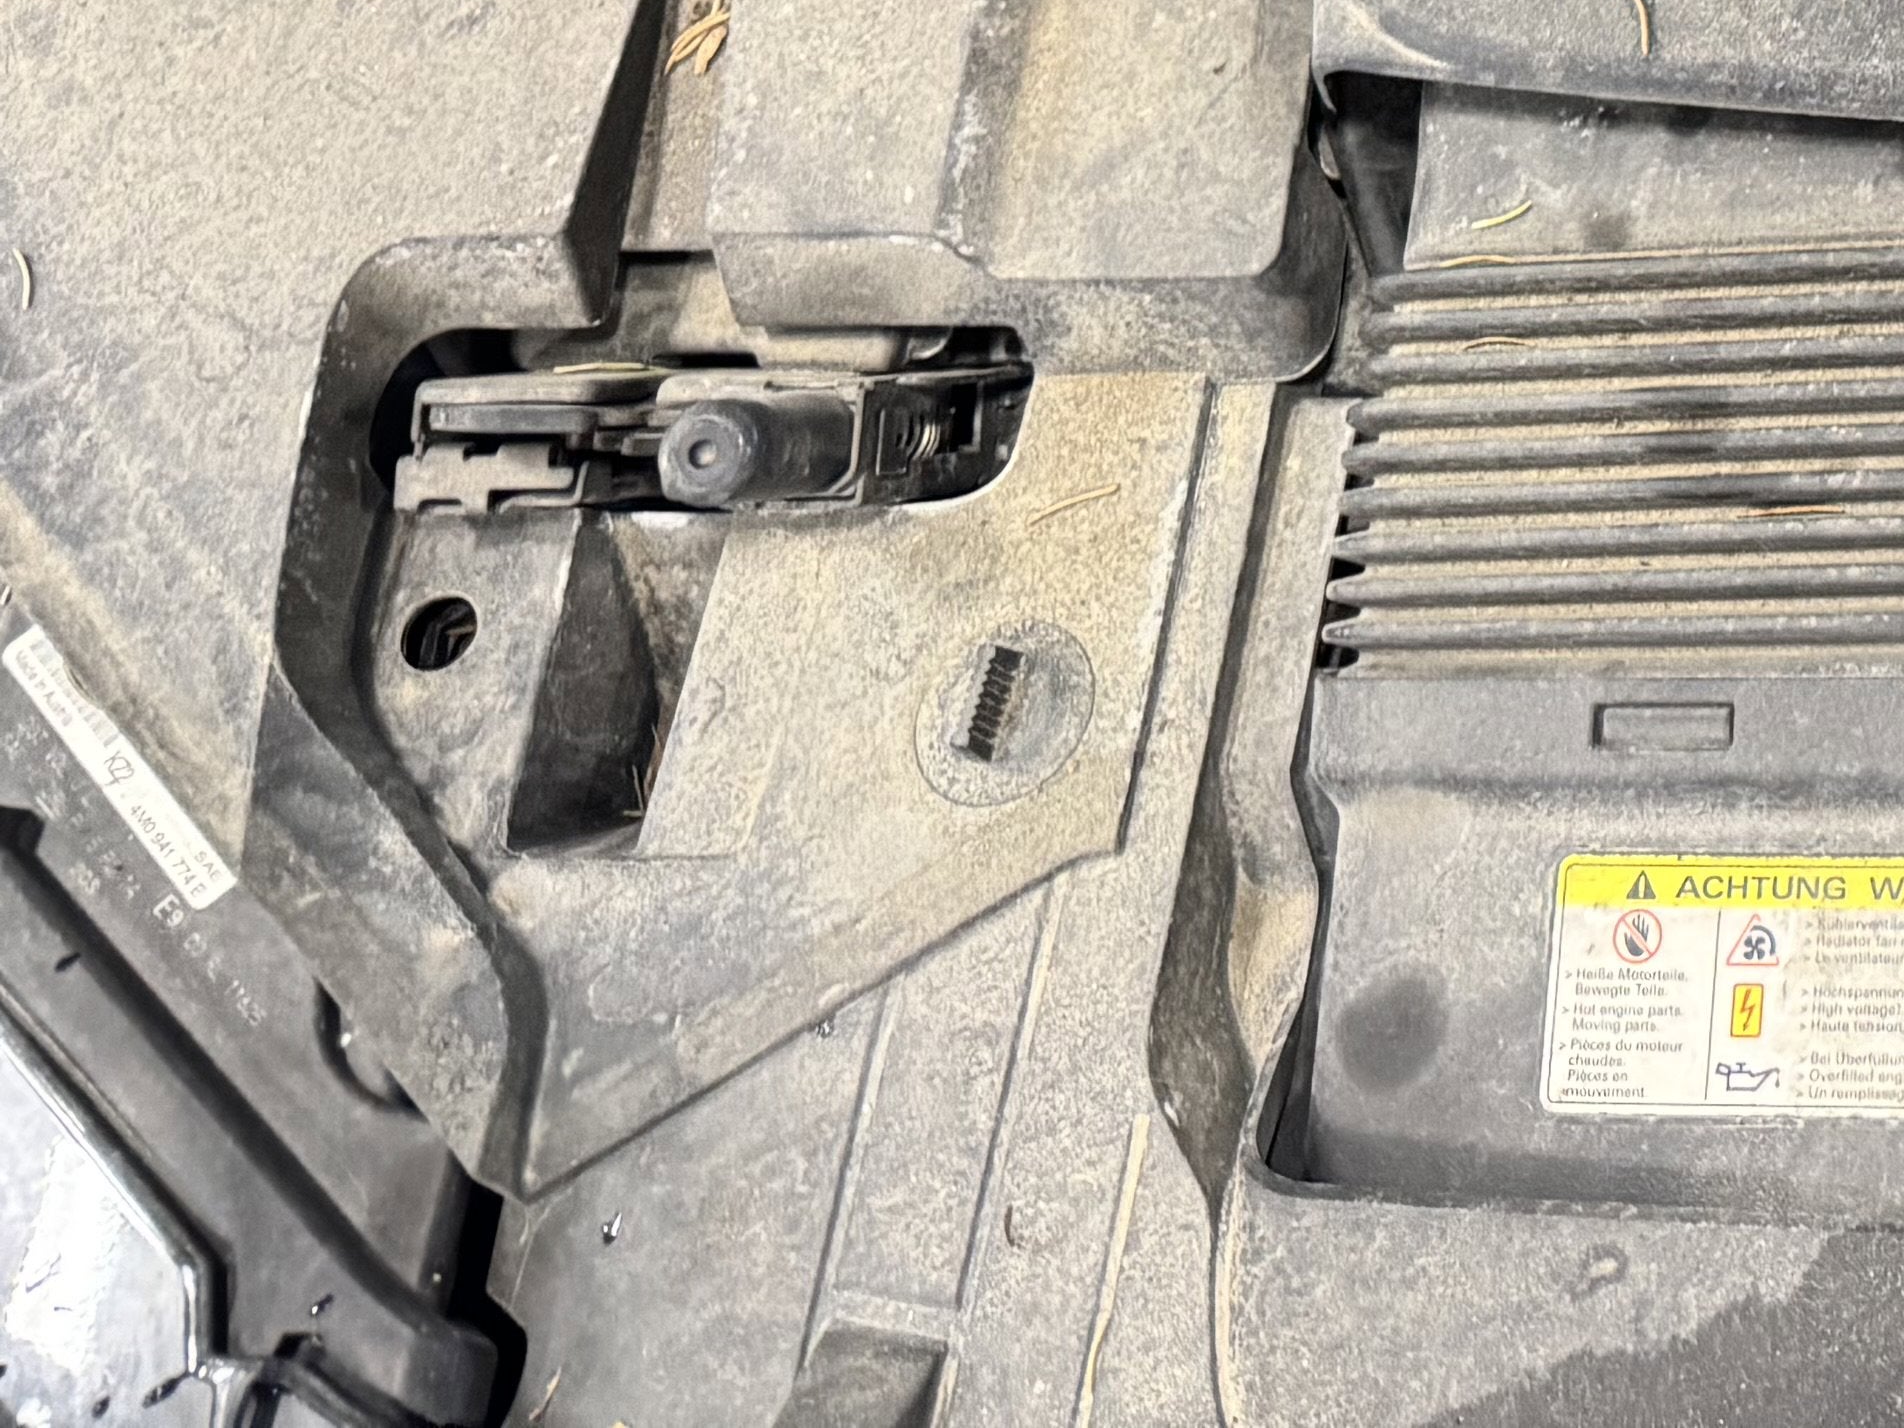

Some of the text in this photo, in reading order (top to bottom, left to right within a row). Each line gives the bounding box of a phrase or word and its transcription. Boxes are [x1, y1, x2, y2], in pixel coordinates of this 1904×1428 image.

[151, 832, 175, 859] 941
[172, 857, 197, 886] 774
[194, 850, 222, 882] SAE
[1676, 876, 1847, 901] ACHTUNG
[153, 894, 184, 927] E9
[1575, 982, 1630, 999] Bewegte
[1573, 1002, 1596, 1016] Hot
[1600, 1005, 1644, 1018] engine
[1812, 1002, 1842, 1017] High
[1572, 1017, 1621, 1034] Moving
[1615, 1039, 1632, 1051] du
[1636, 1040, 1683, 1052] moteur
[1810, 1051, 1831, 1065] Bei
[1612, 1072, 1628, 1082] en
[1809, 1068, 1874, 1082] Overfilled
[1808, 1085, 1827, 1099] Un
